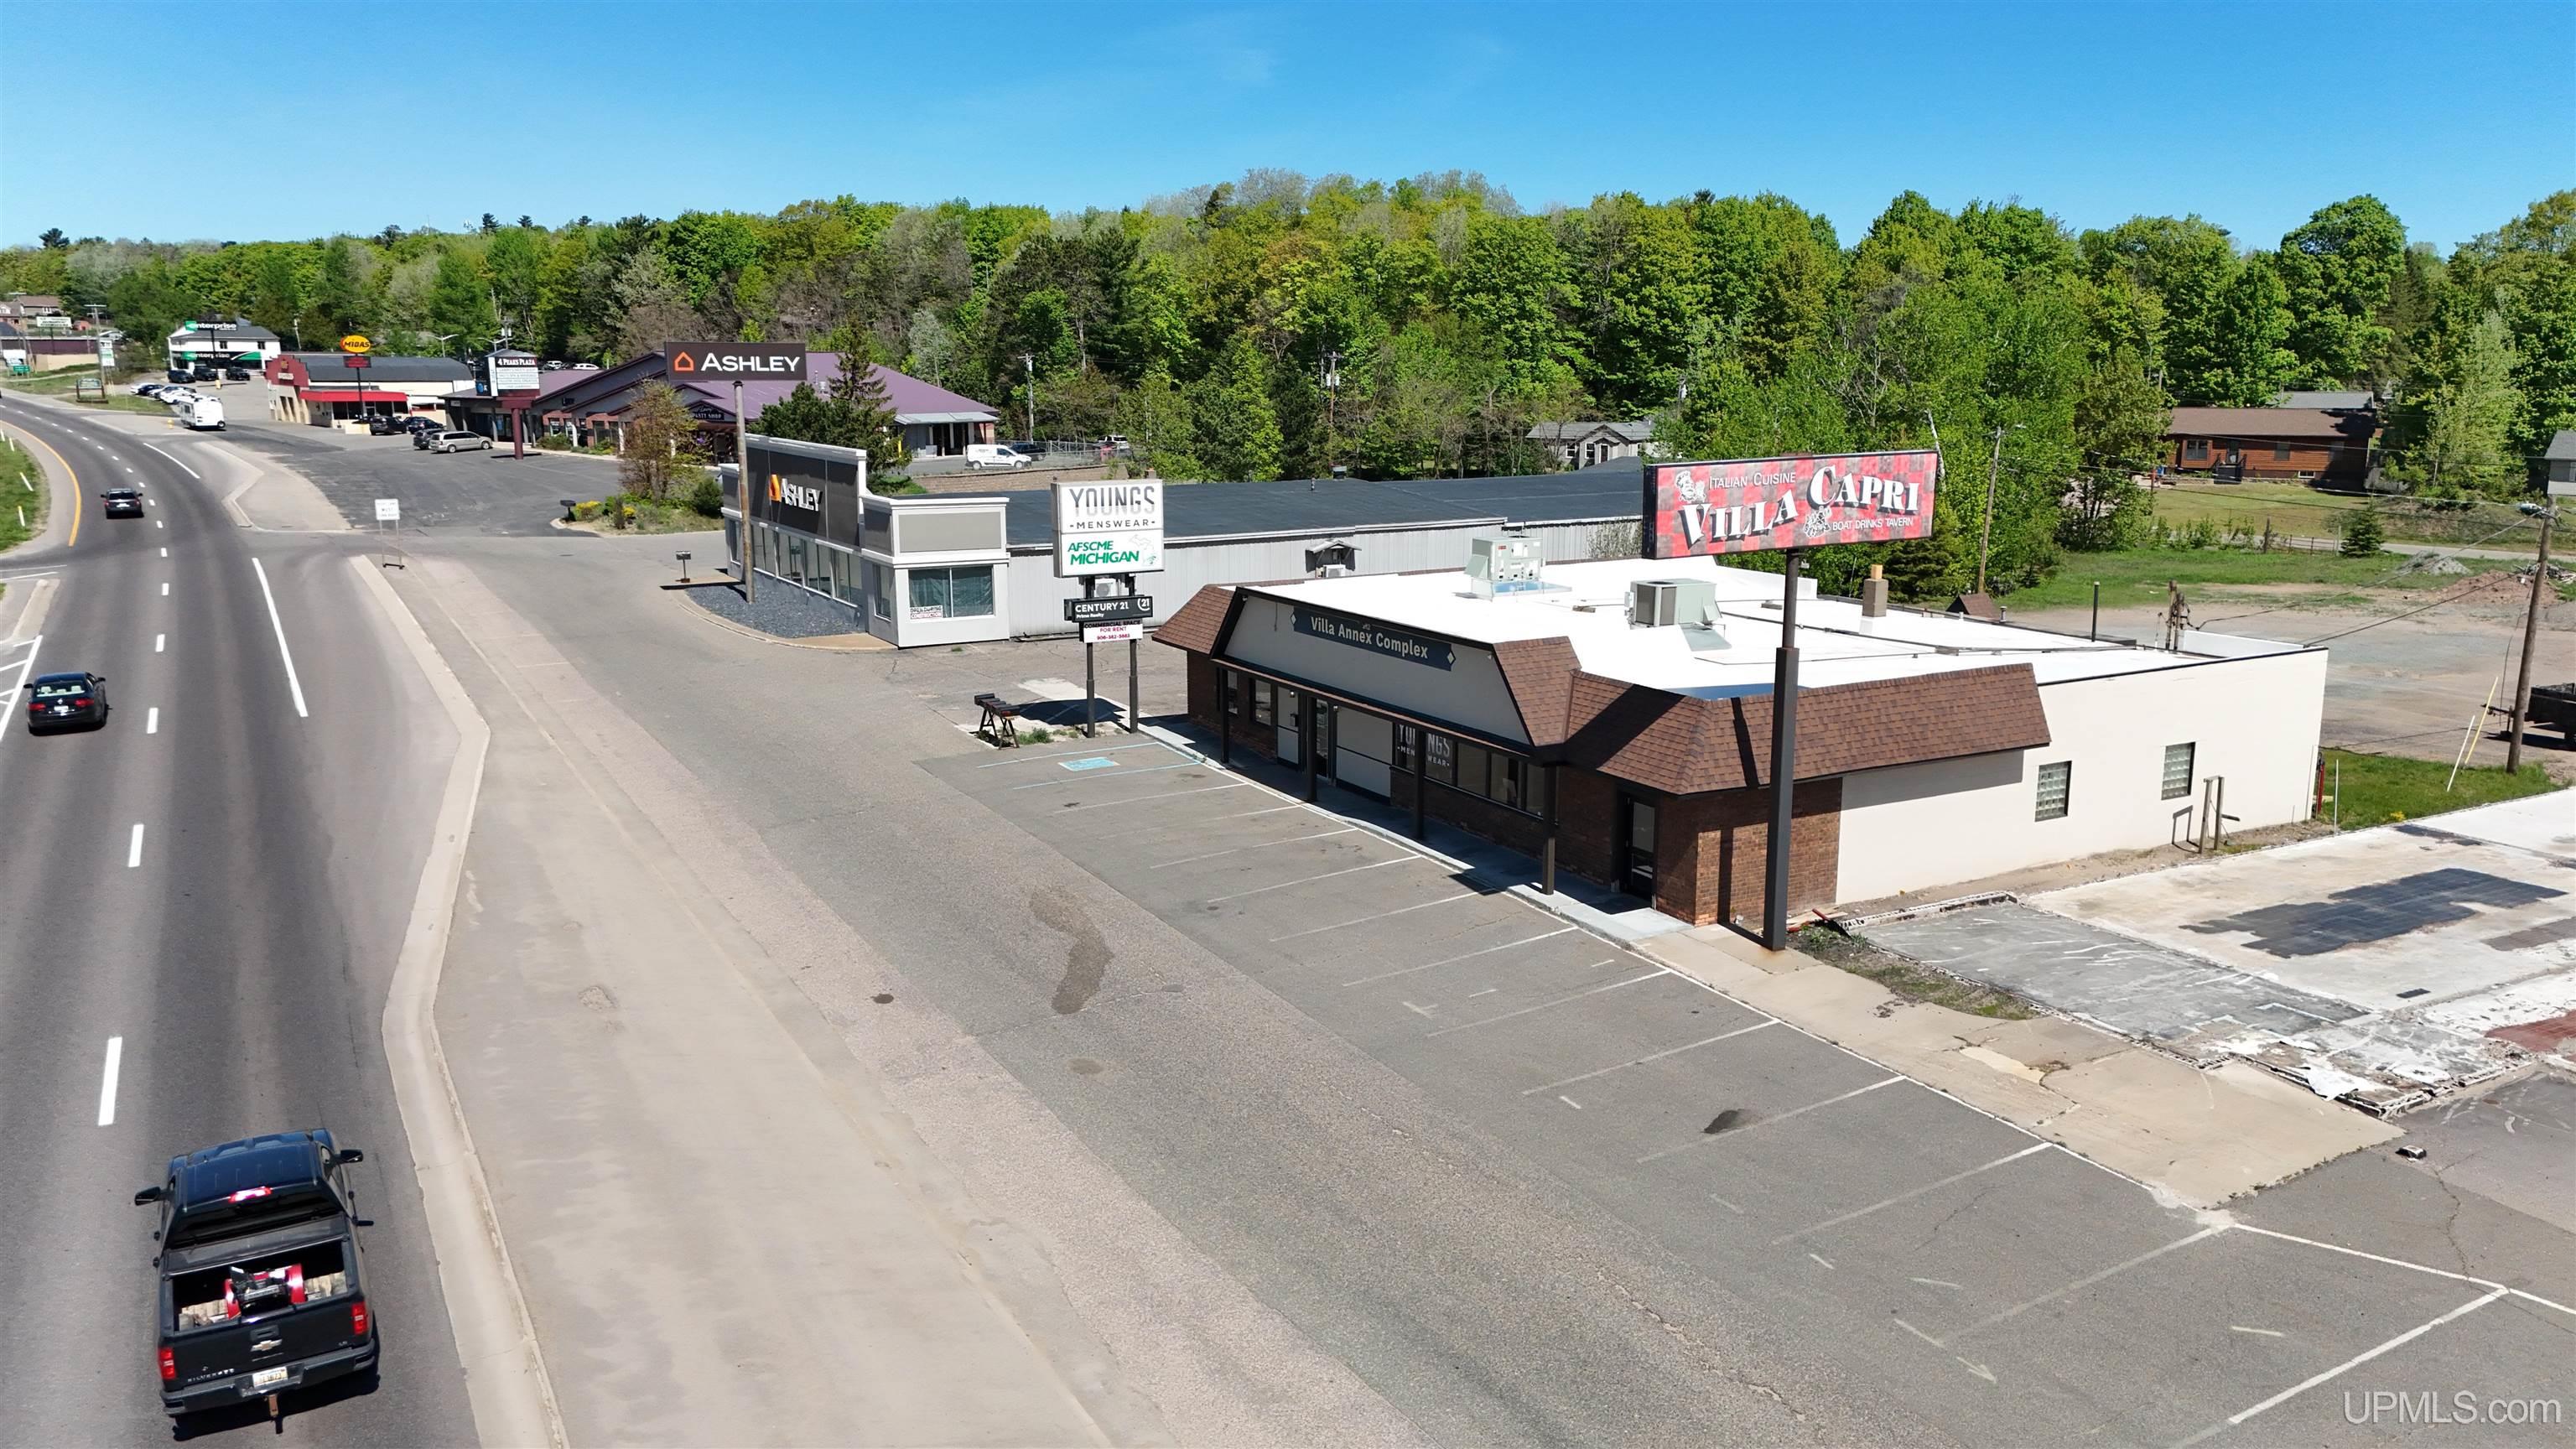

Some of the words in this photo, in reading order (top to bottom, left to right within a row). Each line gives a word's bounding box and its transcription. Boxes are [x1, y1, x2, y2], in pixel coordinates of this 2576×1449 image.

[700, 352, 800, 371] ASHLEY
[1709, 475, 1748, 489] ITALIAN
[1753, 472, 1796, 486] CUISINE
[781, 478, 821, 512] ASHLEY
[1069, 486, 1155, 517] YOUNGS
[1680, 489, 1799, 548] VILLA
[1808, 465, 1920, 513] CAPRI
[1832, 520, 1852, 531] BOAT
[1855, 518, 1883, 529] DRINKS
[1886, 517, 1913, 527] TAVERN
[1067, 541, 1114, 552] AFSCME
[1070, 551, 1140, 565] MICHIGAN
[1075, 602, 1119, 612] CENTURY
[1119, 601, 1130, 610] 21
[1311, 616, 1334, 635] Villa
[1338, 623, 1372, 644] Annex
[1375, 632, 1428, 658] Complex
